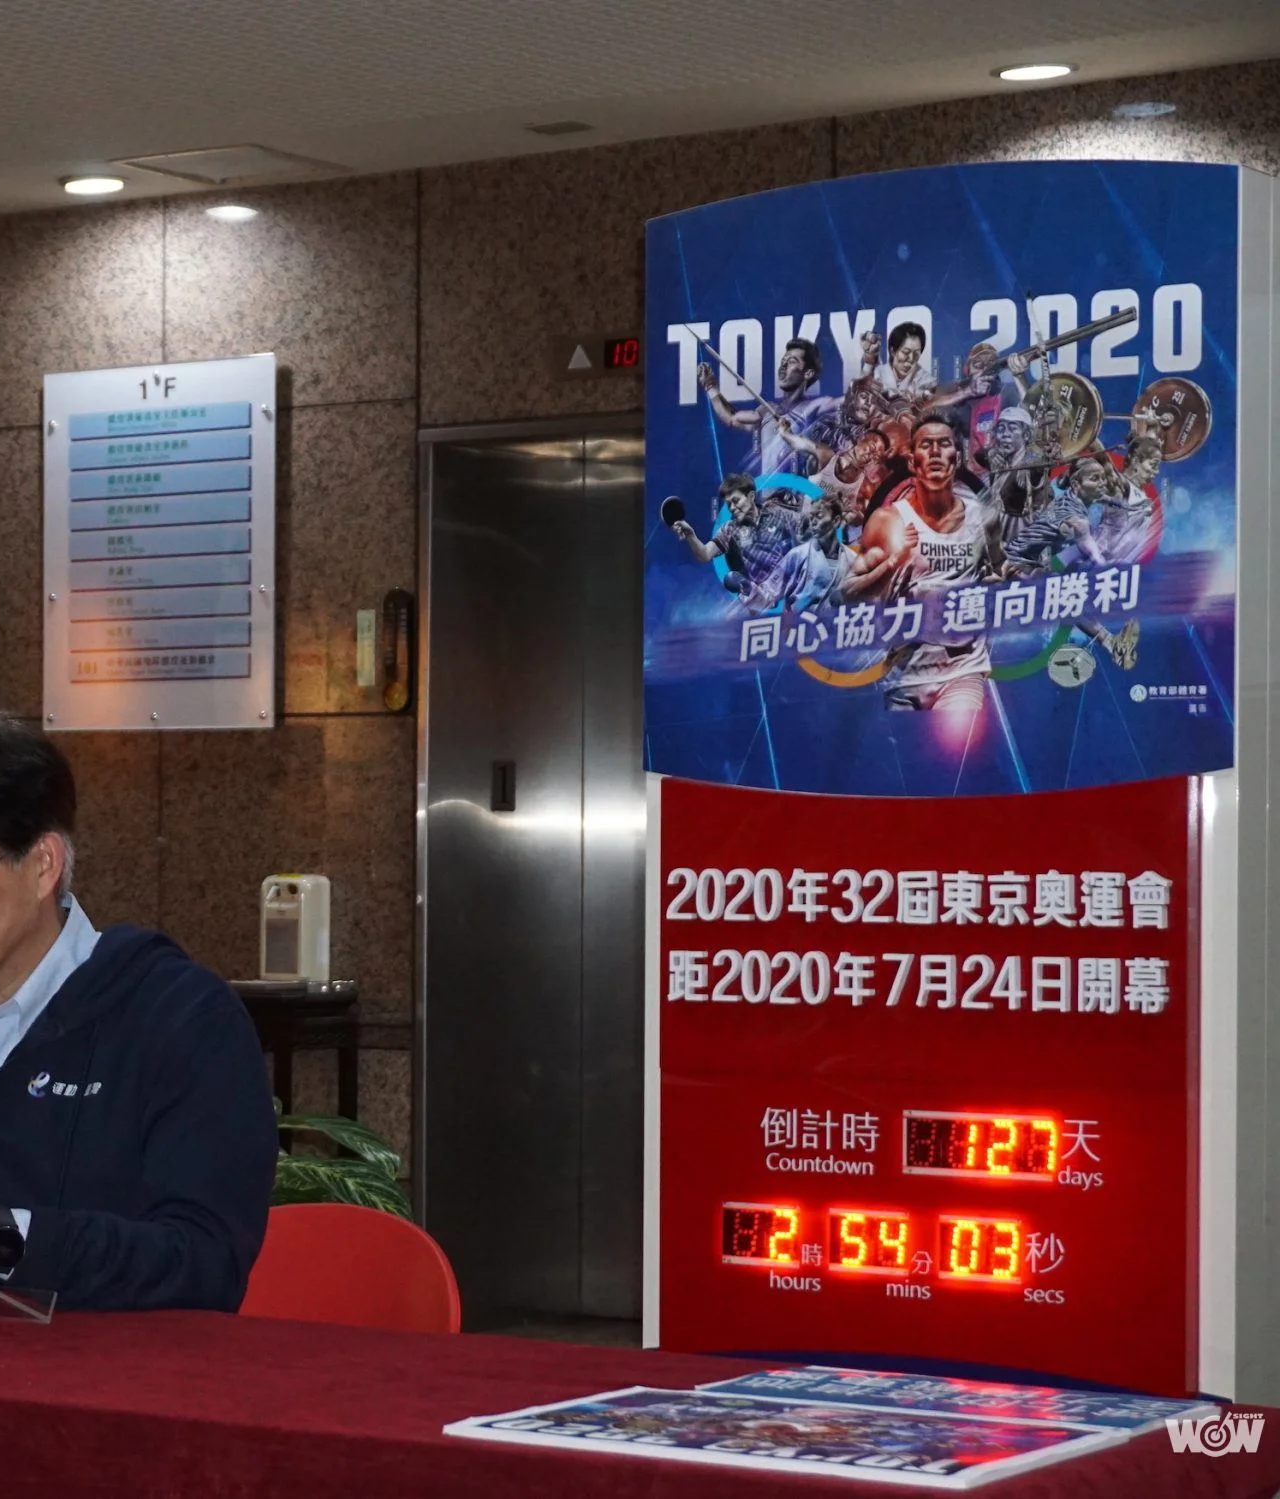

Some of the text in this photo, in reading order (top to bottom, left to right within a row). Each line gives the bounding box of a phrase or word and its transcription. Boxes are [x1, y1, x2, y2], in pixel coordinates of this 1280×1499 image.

[613, 339, 638, 366] 10
[667, 283, 1202, 405] TOKYO 2020
[920, 542, 973, 557] CHINESE
[927, 557, 969, 572] TAIPEI
[740, 564, 1141, 662] 同心協力 邁向勝利
[666, 867, 1173, 929] 2020年32屆東京奧運會
[667, 949, 1170, 1014] 距2020年7月24日開幕
[760, 1107, 1101, 1175] 倒計時 127 天
[765, 1152, 1104, 1188] Countdown days
[768, 1208, 1065, 1277] 2 時 54 分 03 秒
[769, 1271, 1065, 1304] hours mins secs
